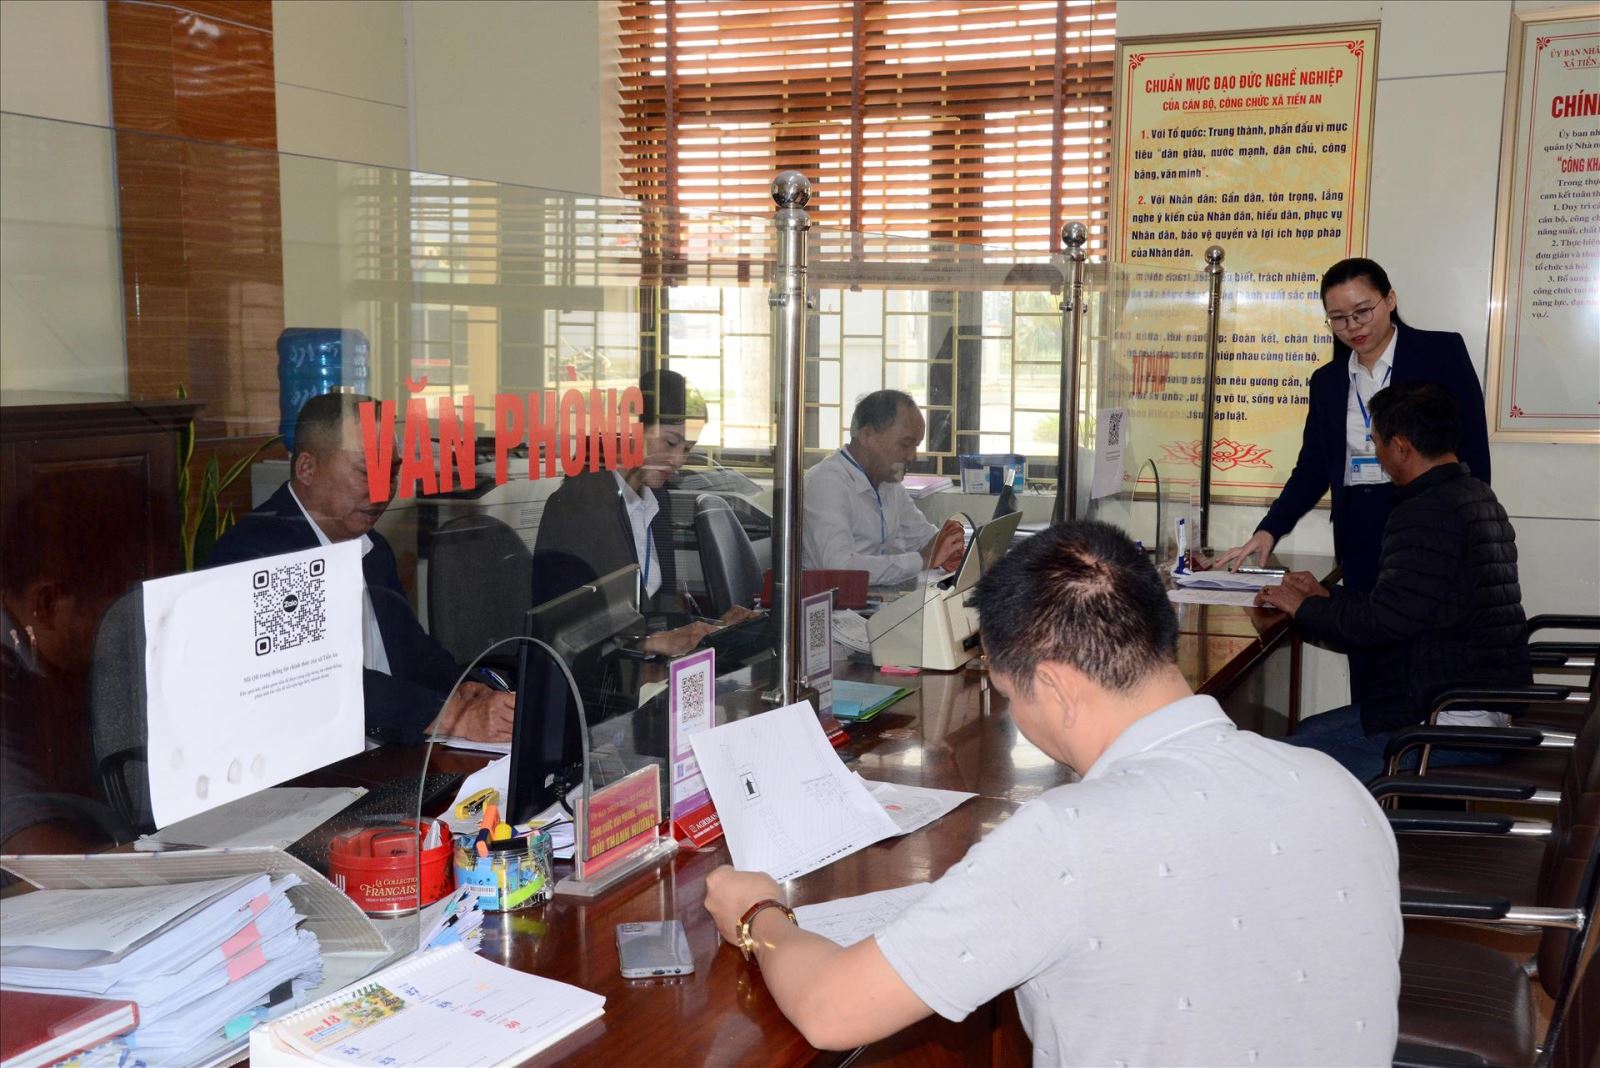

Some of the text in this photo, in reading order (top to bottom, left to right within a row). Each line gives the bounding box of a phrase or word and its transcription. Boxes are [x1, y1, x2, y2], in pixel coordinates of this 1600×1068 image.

[1564, 48, 1581, 56] BAN
[1145, 67, 1343, 94] CHUẨN MỰC ĐẠO ĐỨC NGHỀ NGHIỆP
[1163, 98, 1180, 111] CỦA
[1182, 99, 1200, 110] CÁN
[1219, 97, 1243, 108] CÔNG
[1246, 95, 1269, 107] CHỨC
[1272, 94, 1283, 106] XÃ
[1287, 92, 1306, 105] TIẾN
[1308, 94, 1322, 104] AN
[1552, 89, 1600, 118] CHÍN
[1141, 121, 1348, 139] 1. Với Tổ quốc: Trung thành, phấn đấu vì mục
[1135, 148, 1152, 159] tiêu
[1183, 148, 1206, 159] giàu,
[1211, 147, 1234, 157] nước
[1239, 146, 1268, 157] mạnh,
[1273, 145, 1290, 154] dân
[1296, 143, 1316, 154] chủ,
[1322, 143, 1346, 153] công
[1161, 168, 1176, 178] văn
[1138, 196, 1146, 204] 2.
[1151, 194, 1164, 204] Với
[1170, 194, 1192, 204] Nhân
[1198, 194, 1217, 203] dân:
[1222, 192, 1239, 203] Gần
[1244, 193, 1264, 202] dân,
[1269, 192, 1284, 202] tôn
[1322, 189, 1343, 201] lắng
[1133, 213, 1154, 223] nghe
[1157, 212, 1162, 223] ý
[1165, 211, 1184, 222] kiến
[1188, 211, 1204, 221] của
[1207, 211, 1230, 221] Nhân
[1234, 211, 1253, 221] dân,
[1280, 210, 1300, 220] dân,
[1304, 210, 1328, 221] phục
[1331, 211, 1342, 220] vụ
[1132, 227, 1341, 241] Nhân dân, bảo vệ quyền và lợi ích hợp pháp
[1131, 247, 1193, 257] của Nhân dân.
[1258, 272, 1283, 282] trách
[1286, 272, 1318, 284] nhiệm,
[1232, 333, 1256, 343] Đoàn
[1236, 352, 1259, 360] nhau
[1261, 352, 1283, 362] cùng
[1305, 352, 1320, 363] bộ.
[1230, 376, 1246, 385] nêu
[1250, 378, 1278, 387] gương
[1224, 394, 1235, 402] vô
[1252, 393, 1274, 404] sống
[1277, 395, 1288, 404] và
[1290, 395, 1308, 404] làm
[1227, 412, 1247, 422] luật.
[359, 366, 644, 504] VĂN PHÒNG
